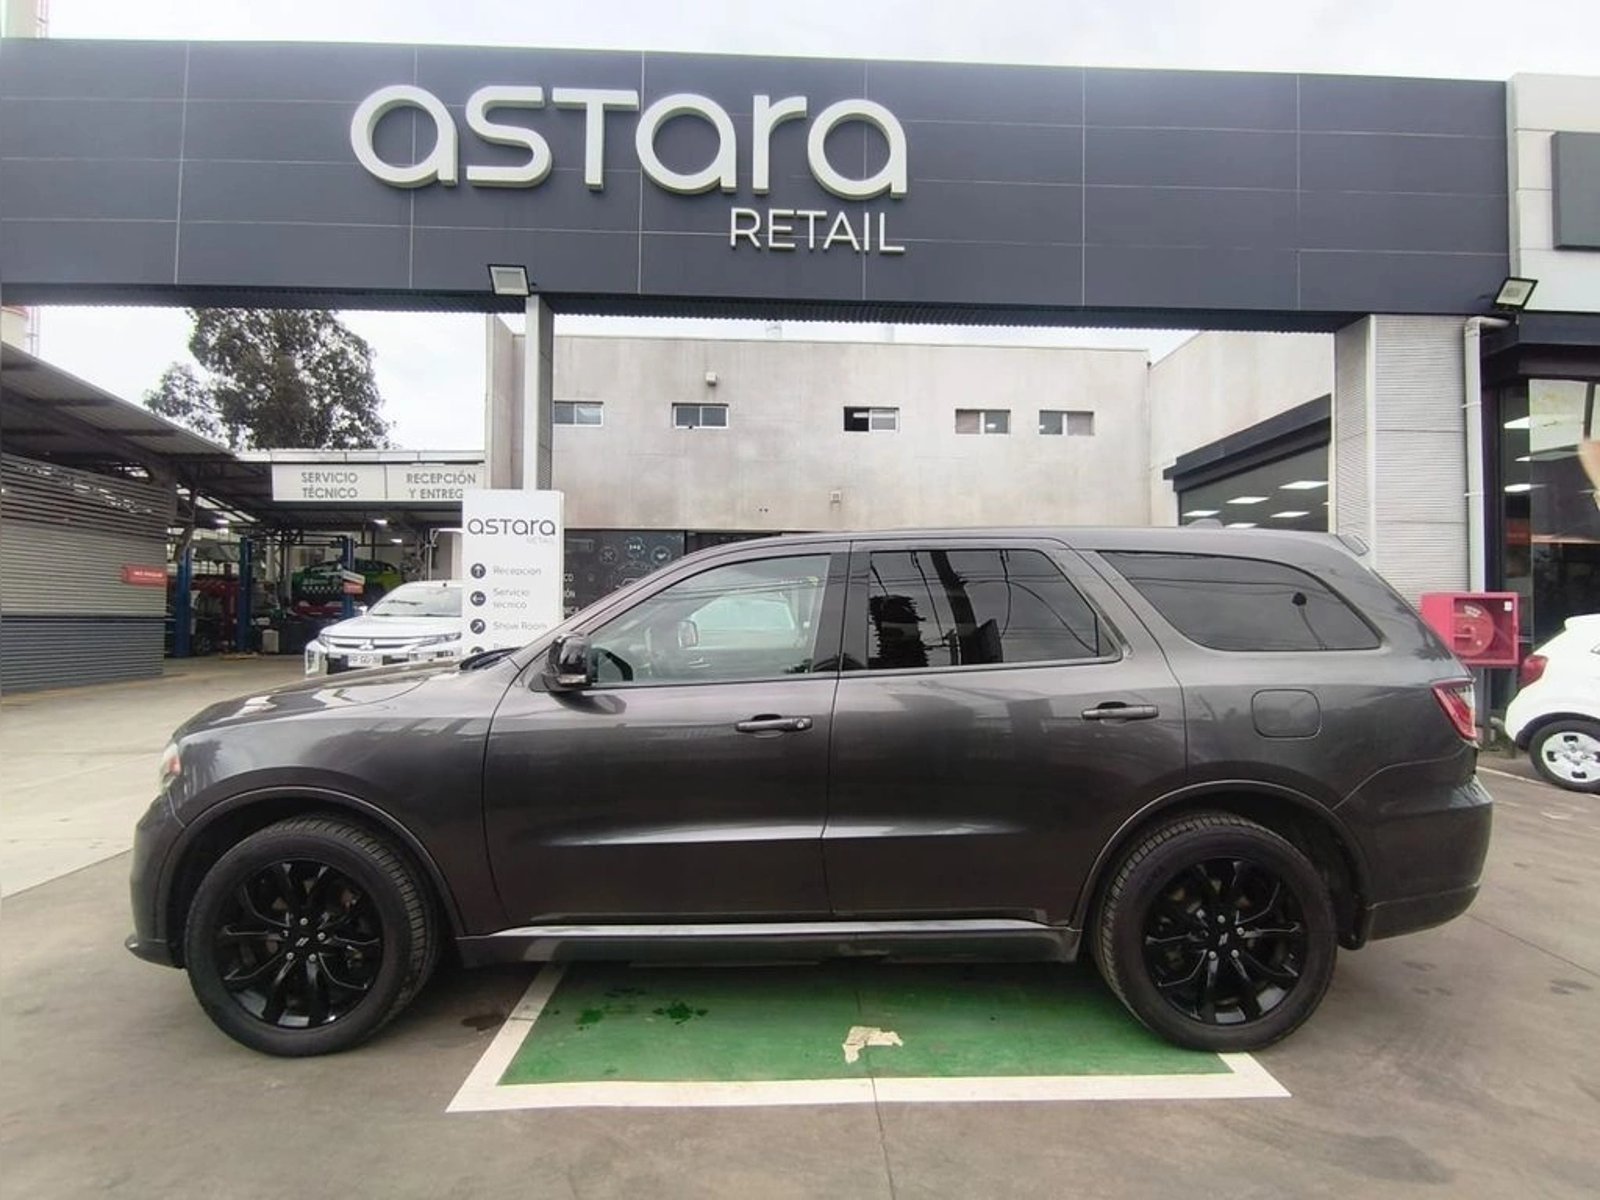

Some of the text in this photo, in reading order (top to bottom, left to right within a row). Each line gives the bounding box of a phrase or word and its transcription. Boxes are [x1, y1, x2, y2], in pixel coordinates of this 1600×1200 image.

[350, 84, 908, 200] astara
[729, 207, 906, 254] RETAIL
[301, 472, 358, 484] SERVICIO
[406, 470, 476, 484] RECEPCIÓN
[302, 485, 358, 499] TÉCNICO
[409, 488, 464, 499] Y ENTREG
[467, 518, 556, 536] astara
